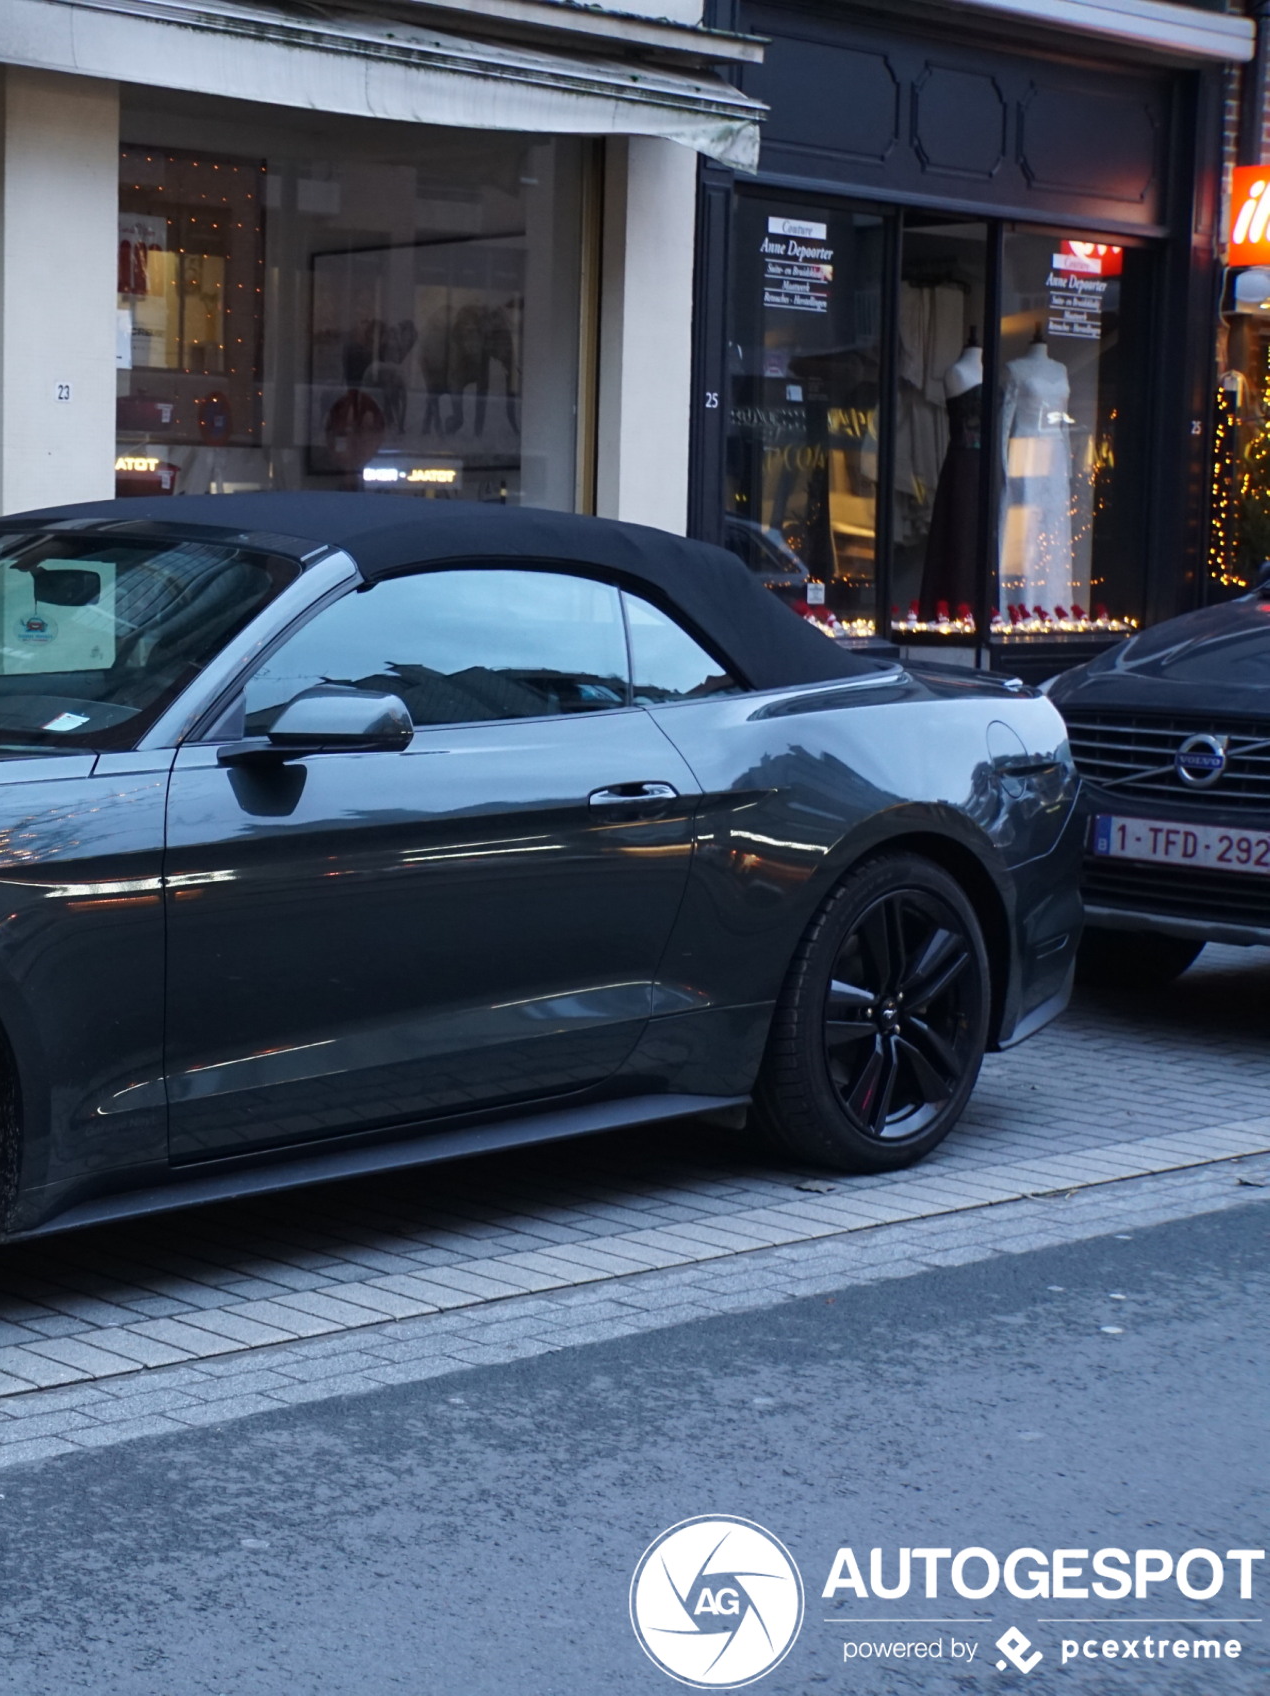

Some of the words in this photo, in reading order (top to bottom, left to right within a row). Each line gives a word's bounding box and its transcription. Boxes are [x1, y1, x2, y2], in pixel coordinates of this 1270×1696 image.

[782, 220, 813, 236] Couture
[760, 237, 786, 255] Anne
[787, 240, 834, 262] Depoorter
[1045, 272, 1068, 287] Anne
[1069, 274, 1108, 295] Depoorter
[57, 384, 70, 400] 23
[705, 391, 719, 409] 25
[1178, 755, 1221, 767] VOLVO
[1116, 825, 1270, 867] 1-TFD-292
